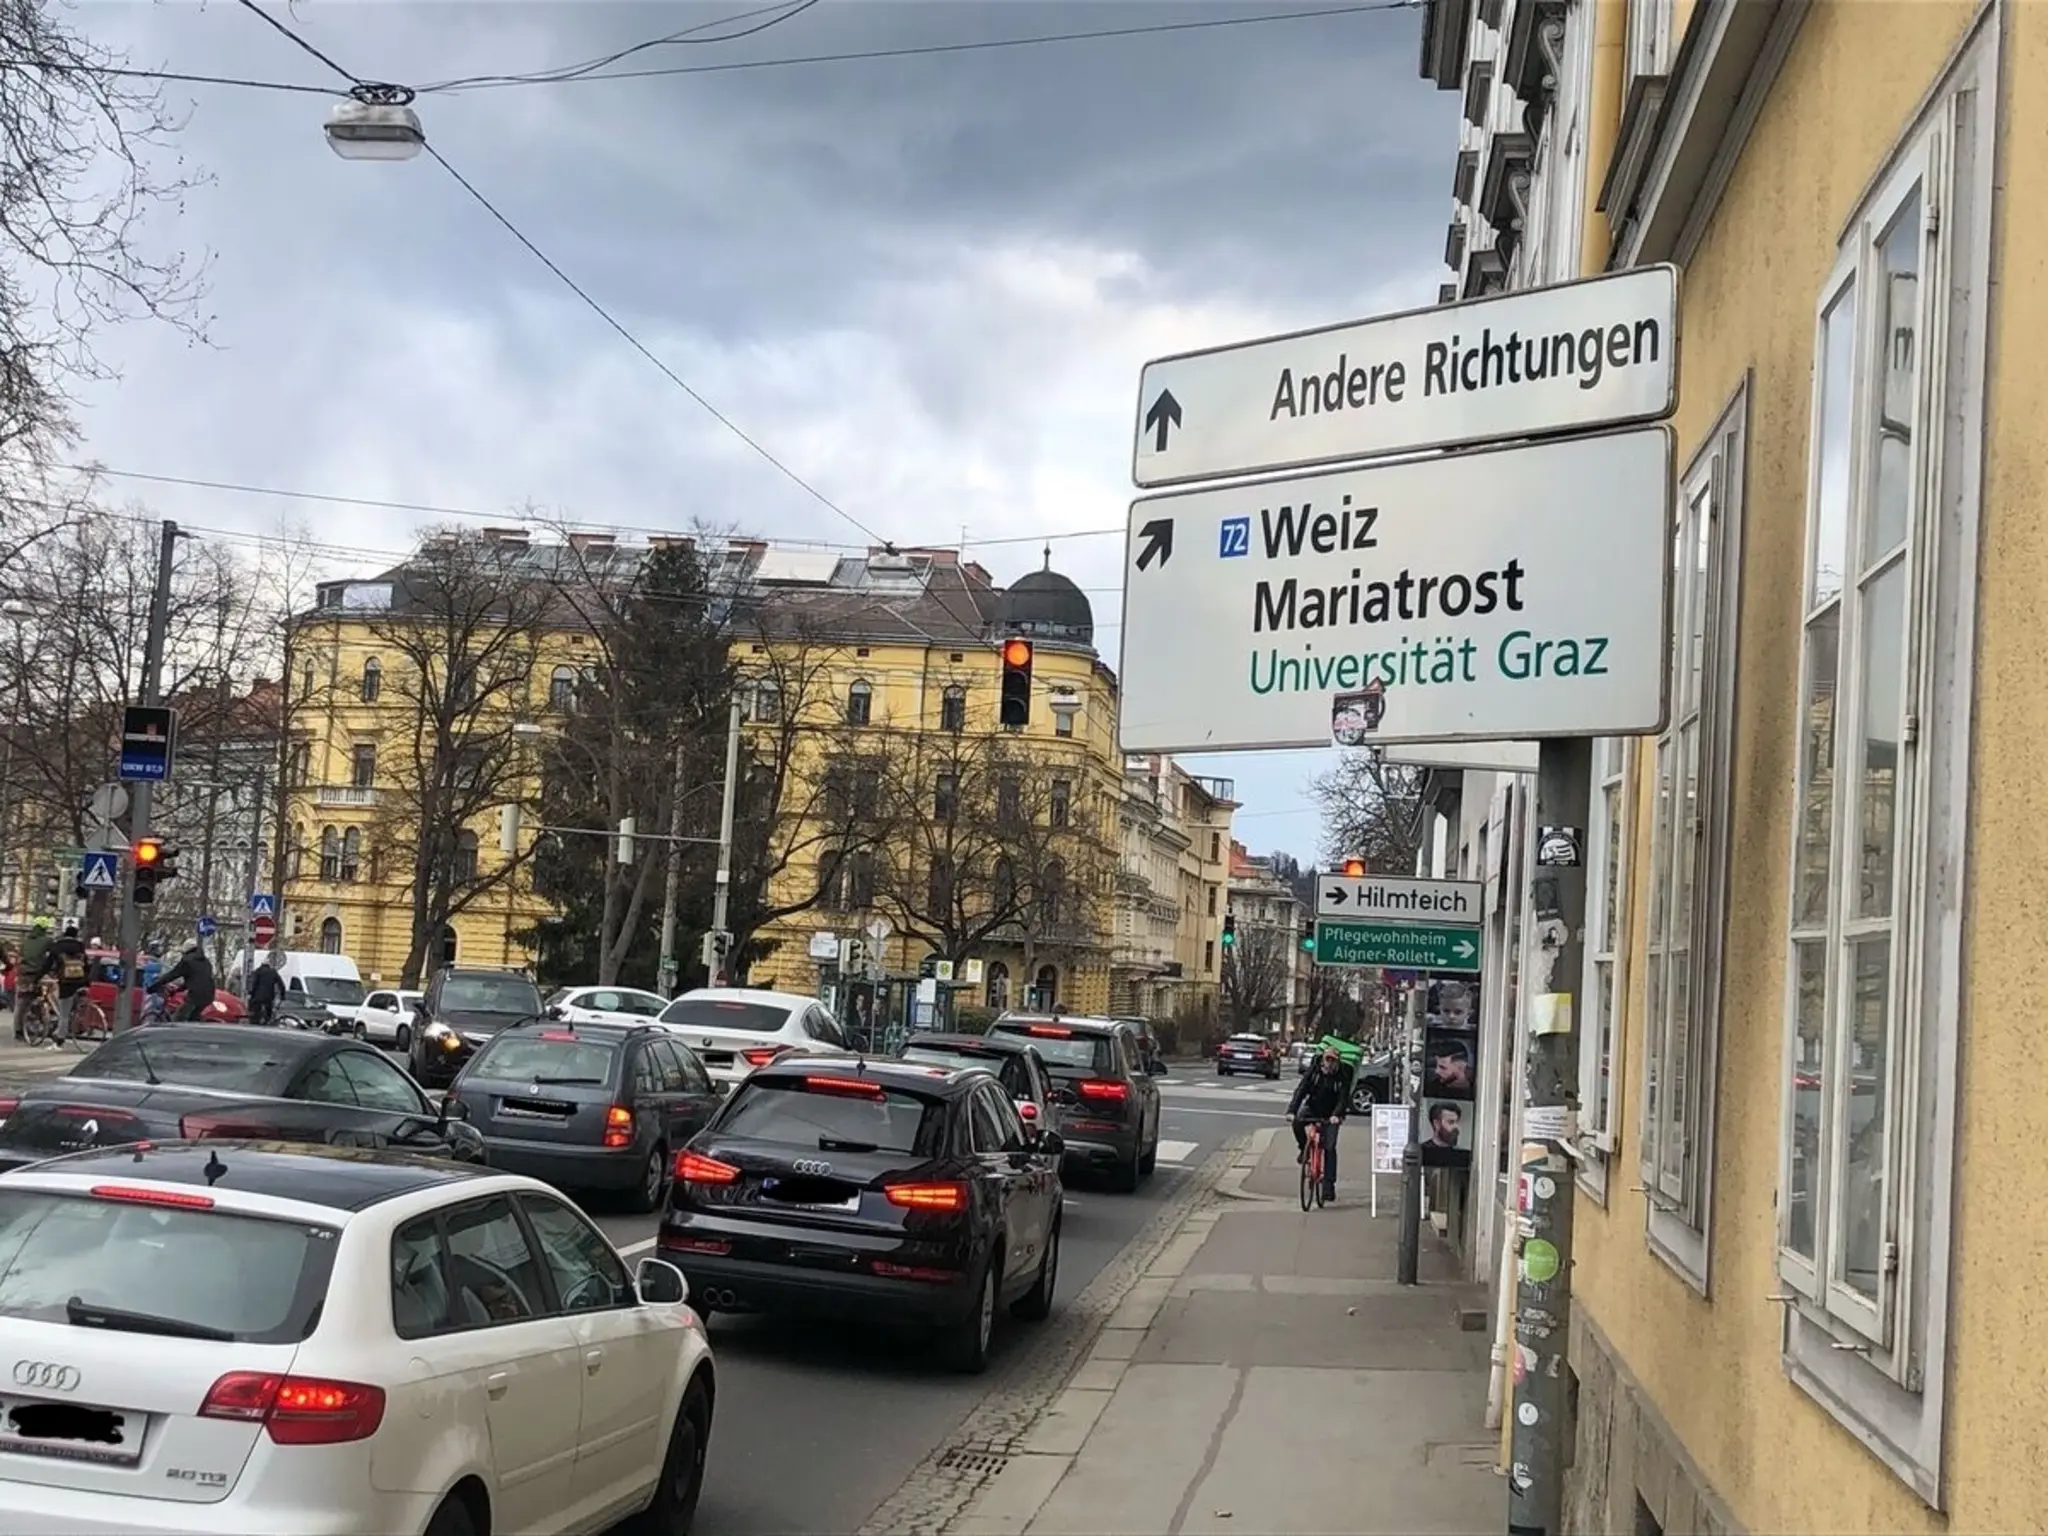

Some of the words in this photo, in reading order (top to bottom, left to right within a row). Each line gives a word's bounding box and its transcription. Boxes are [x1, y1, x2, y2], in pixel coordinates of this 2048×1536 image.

[1269, 354, 1406, 421] Andere
[1423, 316, 1660, 397] Richtungen
[1223, 523, 1246, 553] 72
[1260, 494, 1379, 559] Weiz
[1253, 558, 1525, 633] Mariatrost
[1250, 635, 1477, 695] Universität
[1498, 630, 1609, 681] Graz
[1356, 885, 1467, 912] Hilmteich
[1325, 927, 1447, 945] Pflegewohnheim
[1333, 946, 1436, 965] Aigner-Rollett
